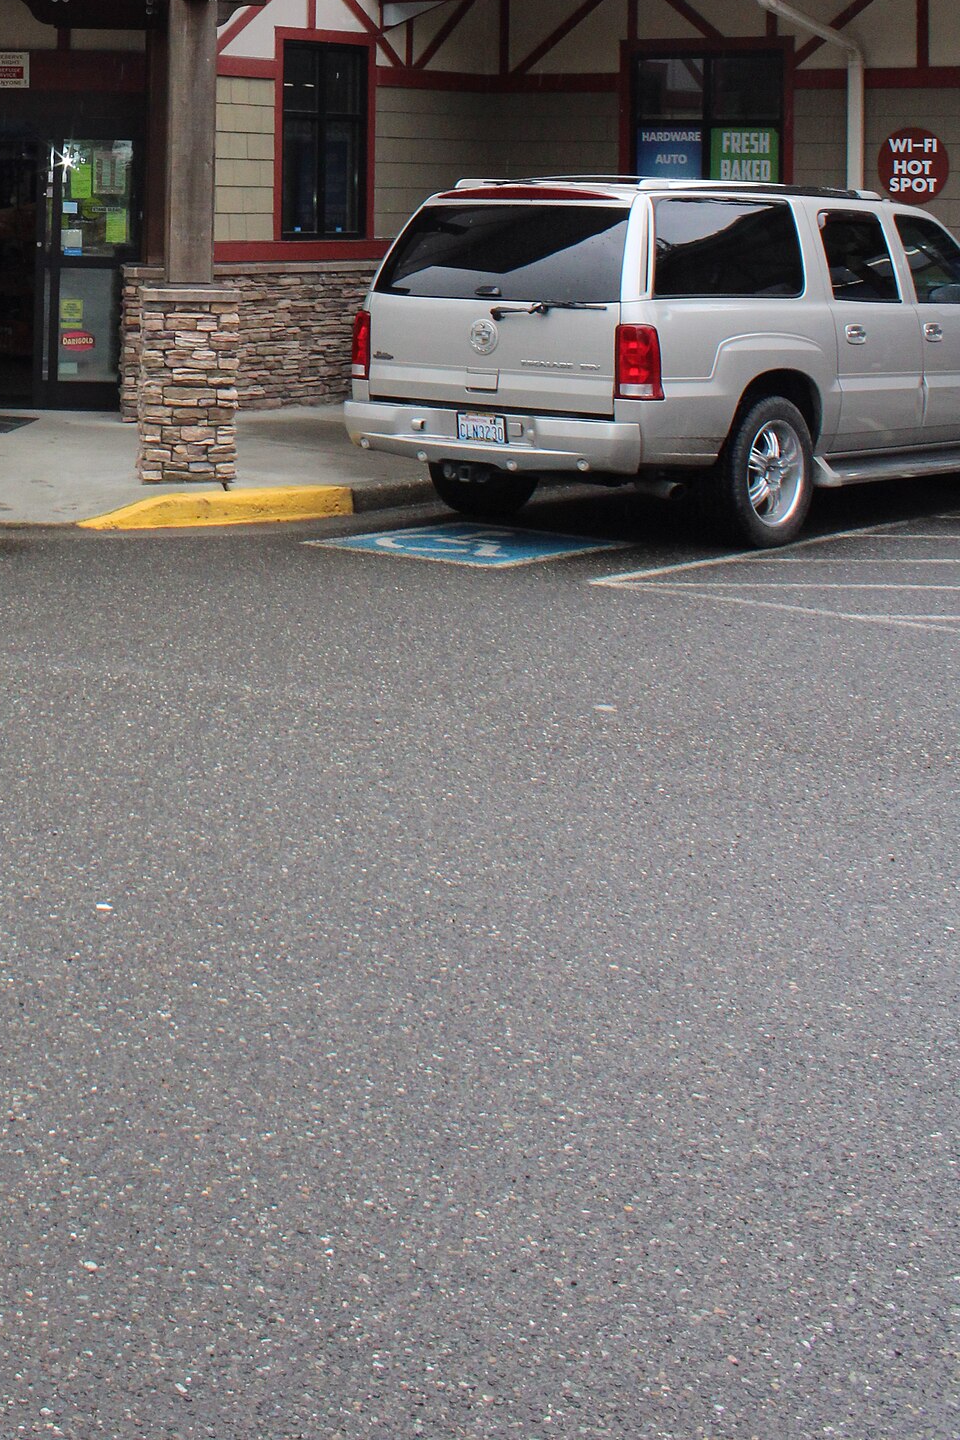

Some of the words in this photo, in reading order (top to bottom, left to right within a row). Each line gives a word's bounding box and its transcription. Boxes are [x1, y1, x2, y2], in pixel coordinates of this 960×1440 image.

[642, 131, 701, 141] HARDWARE
[722, 132, 770, 153] FRESH
[888, 138, 937, 153] WI-FI
[655, 154, 688, 164] AUTO
[721, 160, 771, 180] BAKED
[893, 160, 932, 175] HOT
[889, 177, 937, 193] SPOT
[62, 337, 94, 345] DARIGOLD
